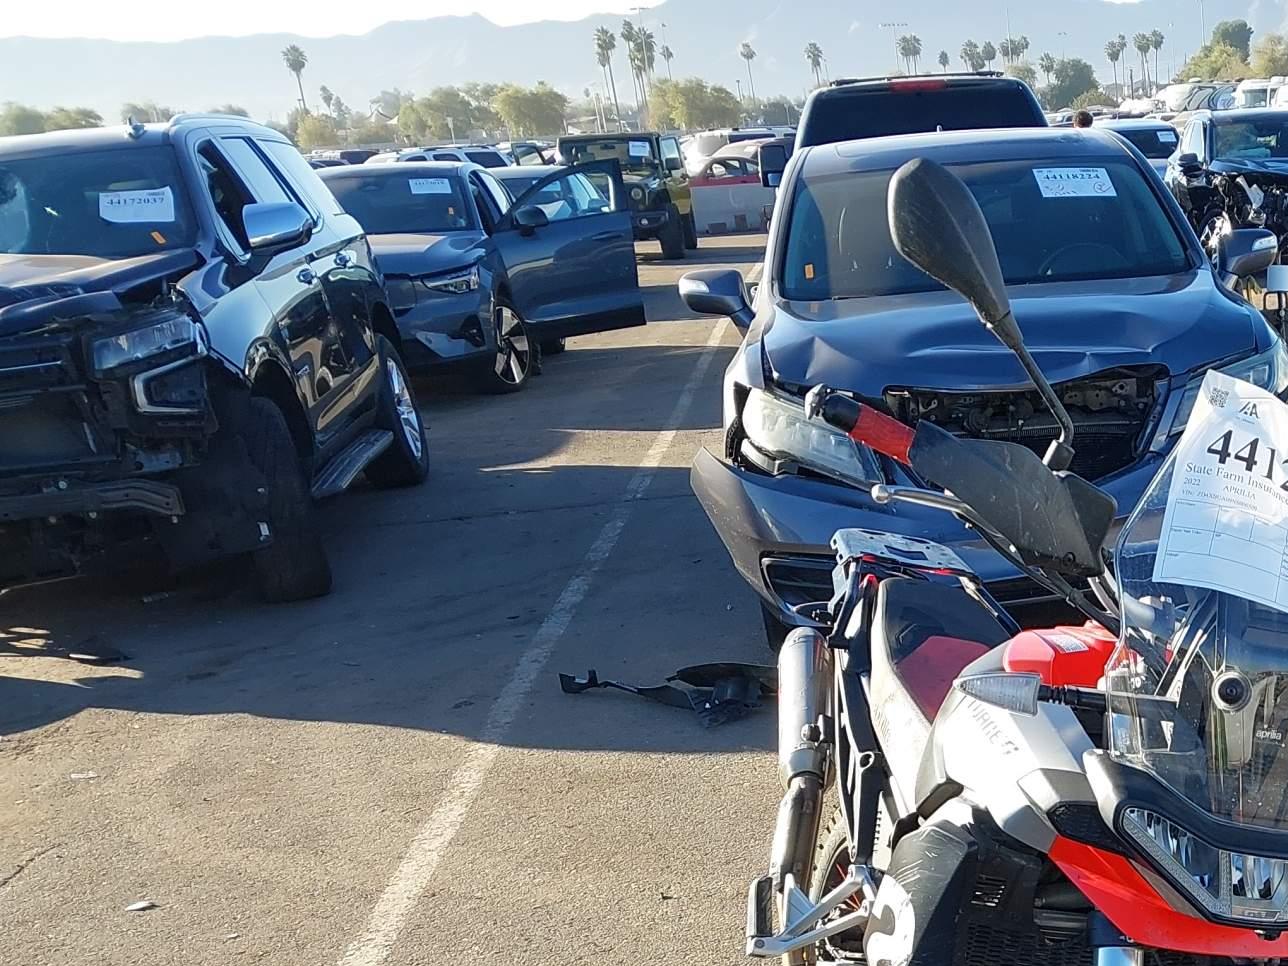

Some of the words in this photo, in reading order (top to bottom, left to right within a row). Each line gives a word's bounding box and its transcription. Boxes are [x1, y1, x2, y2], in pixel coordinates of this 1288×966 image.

[105, 197, 164, 206] 44172037
[1185, 462, 1213, 476] State
[1216, 467, 1244, 483] Farm
[1183, 477, 1201, 486] 2022
[1223, 484, 1257, 500] APRILIA
[1256, 729, 1282, 740] aprilia
